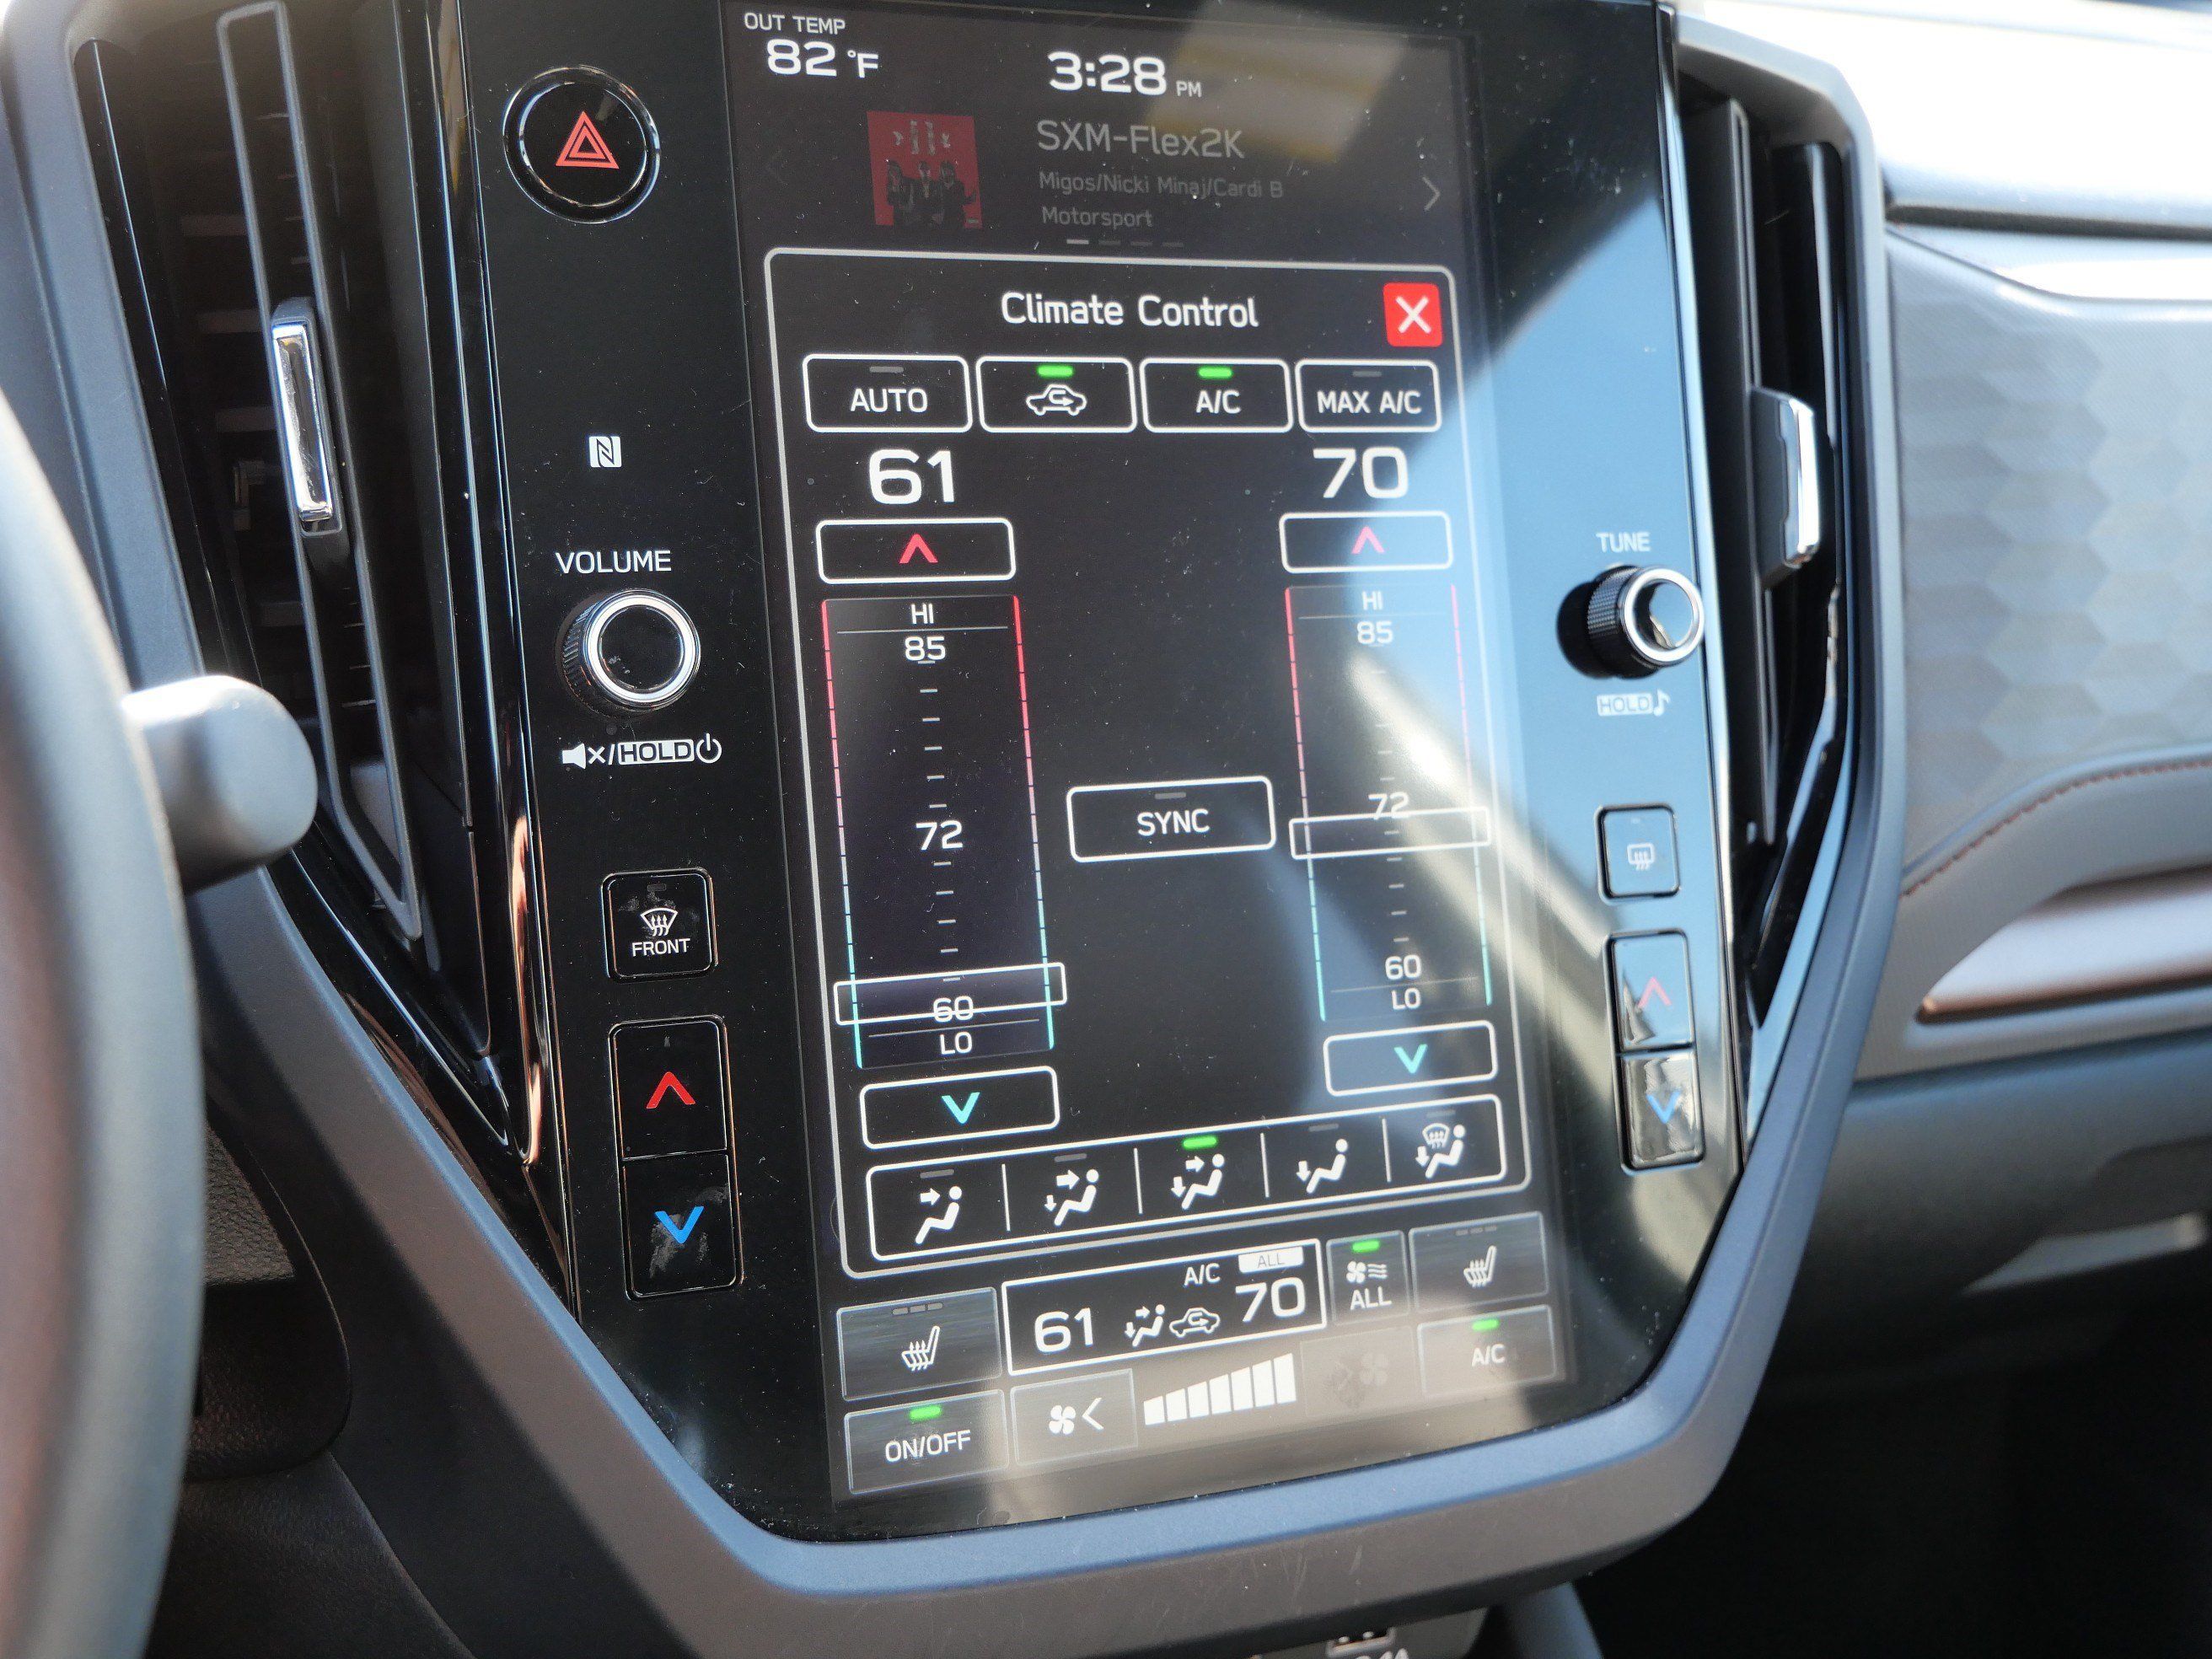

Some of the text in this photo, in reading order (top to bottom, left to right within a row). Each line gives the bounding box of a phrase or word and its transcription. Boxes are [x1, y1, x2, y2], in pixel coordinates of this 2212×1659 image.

[744, 12, 846, 35] OUT TEMP
[766, 39, 837, 77] 82
[1048, 51, 1202, 98] 3:28 PM
[1037, 119, 1244, 159] SXM-Flex2K
[1039, 170, 1150, 196] Migos/Nicki
[1270, 180, 1284, 198] B
[1042, 207, 1152, 229] Motorsport
[1001, 291, 1259, 328] Climate Control
[850, 389, 928, 414] AUTO
[1195, 389, 1240, 416] A/C
[1318, 389, 1421, 415] MAX A/C
[868, 449, 954, 505] 61
[1313, 447, 1409, 499] 70
[1596, 532, 1651, 553] TUNE
[555, 550, 672, 574] VOLUME
[1361, 590, 1383, 610] HI
[911, 603, 934, 625] HI
[1356, 620, 1393, 644] 85
[905, 636, 946, 661] 85
[1598, 695, 1651, 715] HOLD
[1367, 792, 1409, 820] 72
[1137, 808, 1211, 836] SYNC
[915, 819, 964, 851] 72
[632, 937, 691, 958] FRONT
[1385, 956, 1422, 981] 60
[933, 996, 974, 1023] 60
[1391, 988, 1421, 1011] LO
[940, 1031, 972, 1055] LO
[1257, 1253, 1286, 1269] ALL
[1184, 1263, 1221, 1286] A/C
[1235, 1276, 1306, 1323] 70
[1350, 1286, 1393, 1311] ALL
[1035, 1307, 1097, 1354] 61
[1471, 1342, 1506, 1368] A/C
[884, 1429, 972, 1464] ON/OFF
